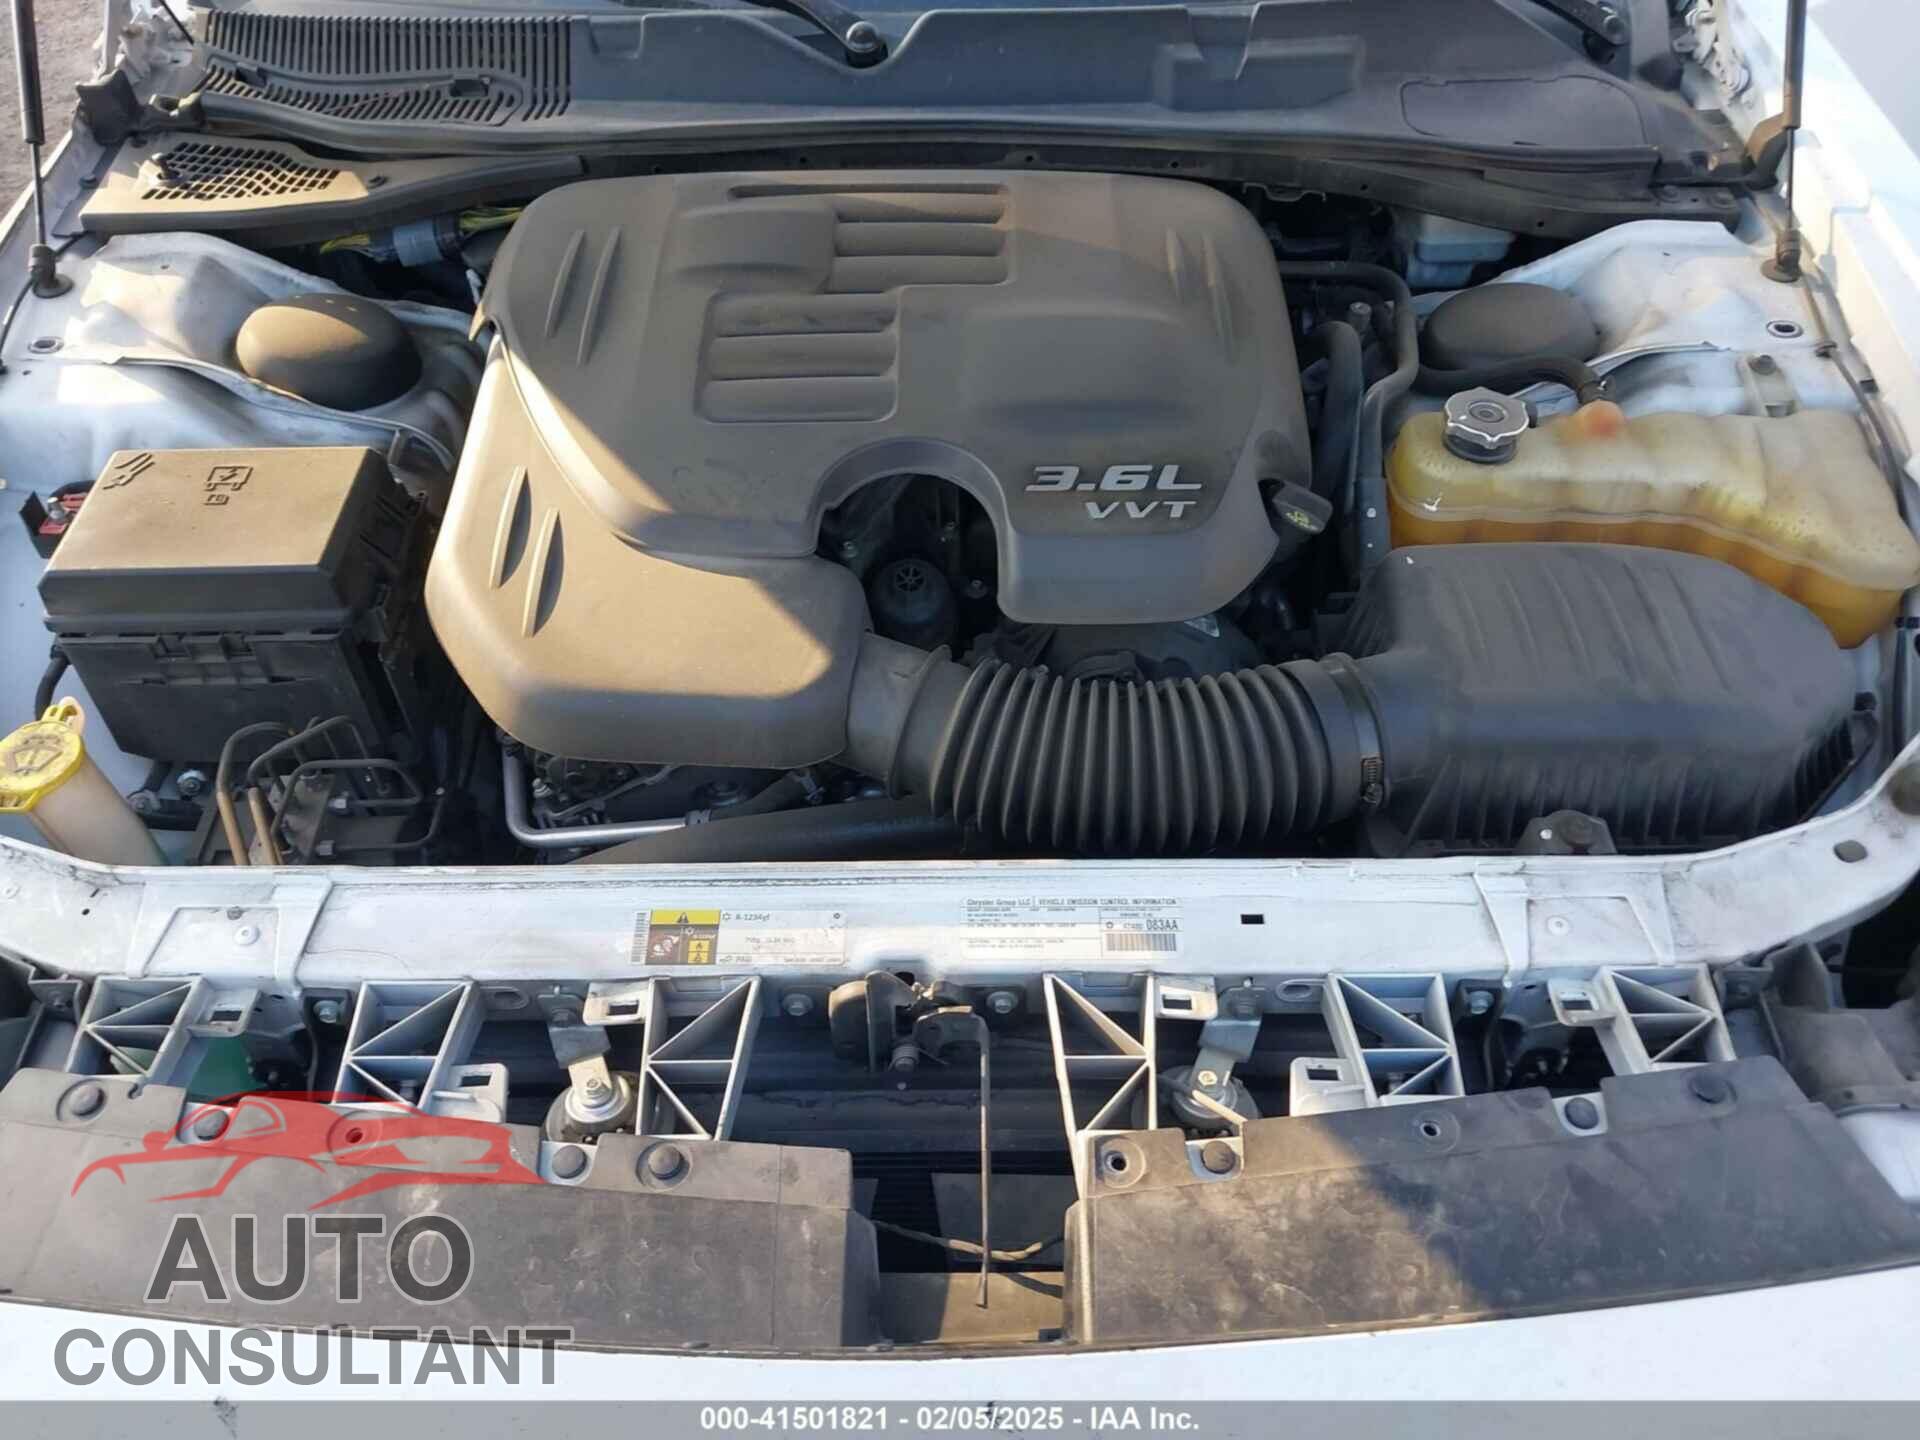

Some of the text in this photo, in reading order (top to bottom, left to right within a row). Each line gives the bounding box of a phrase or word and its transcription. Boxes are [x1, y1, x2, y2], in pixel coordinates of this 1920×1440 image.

[1025, 464, 1203, 492] 3.6L
[1084, 501, 1198, 519] VVT
[997, 898, 1017, 908] Group
[1019, 898, 1031, 907] LLC
[1067, 898, 1098, 906] EMISSION
[1101, 898, 1130, 906] CONTROL
[1132, 898, 1177, 906] INFORMATION
